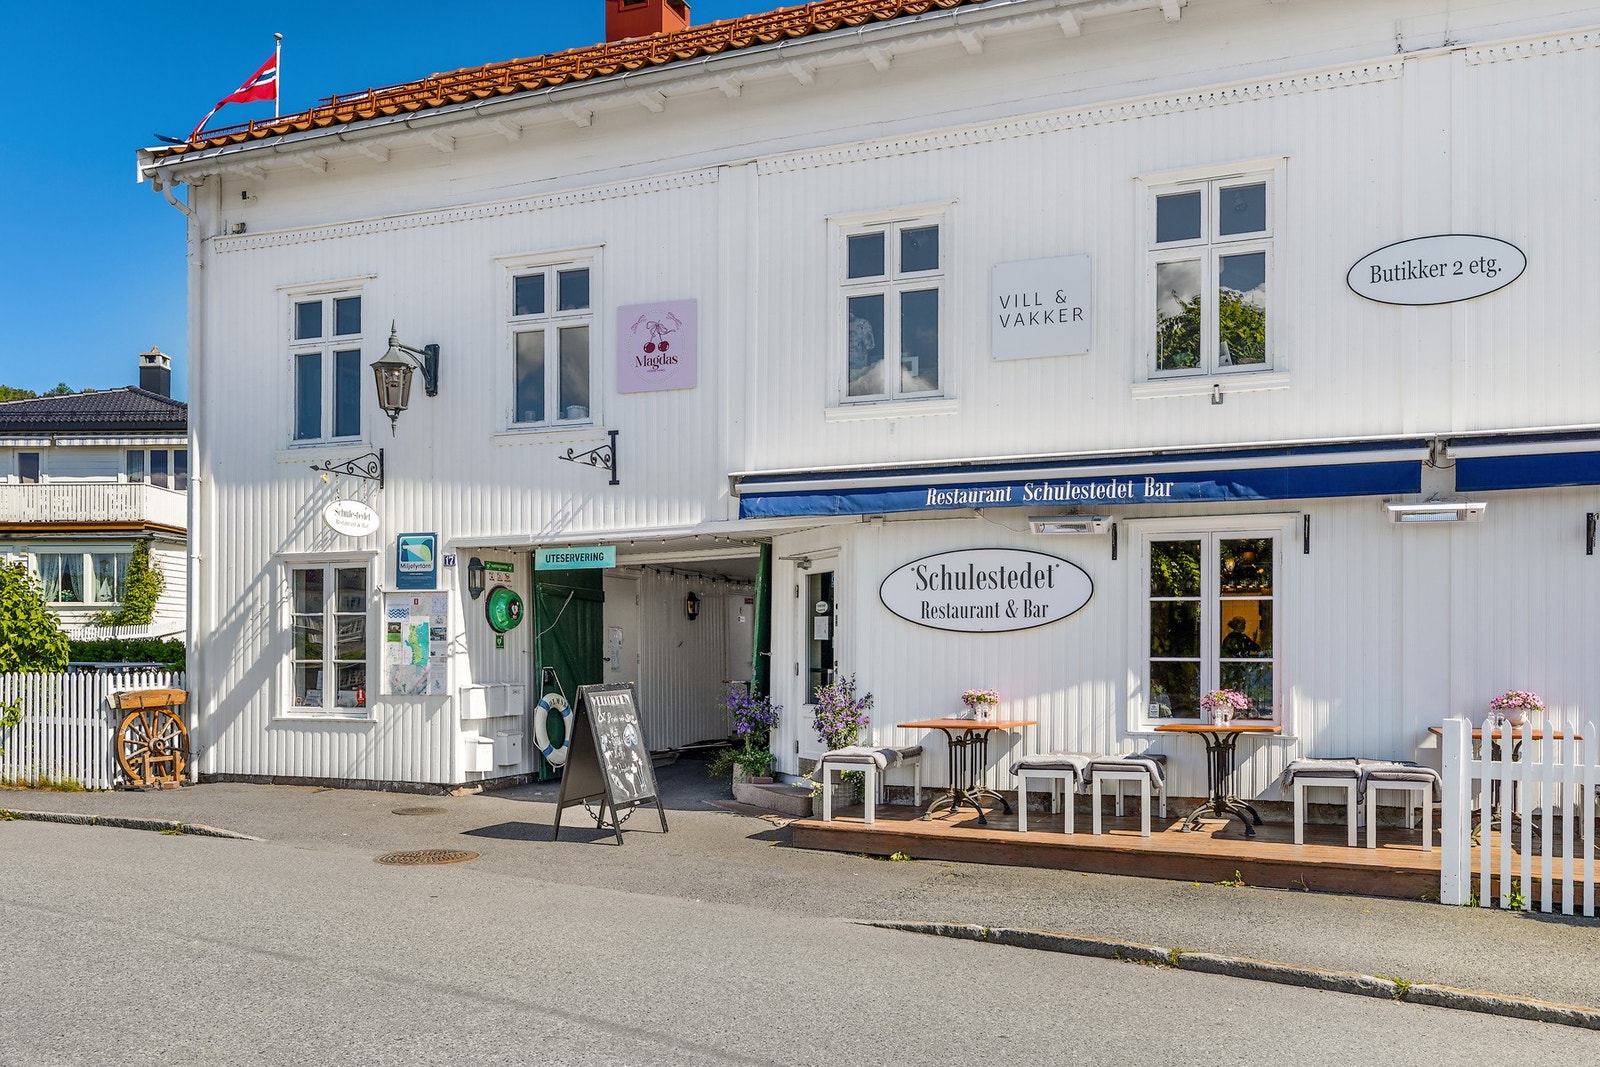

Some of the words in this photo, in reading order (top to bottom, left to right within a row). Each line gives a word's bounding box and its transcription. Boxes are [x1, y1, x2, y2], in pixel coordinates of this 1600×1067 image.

[1369, 258, 1448, 285] Butikker
[1452, 260, 1464, 276] 2
[1468, 256, 1503, 279] etg.
[999, 292, 1043, 310] VILL
[1055, 289, 1067, 304] &
[999, 306, 1084, 329] VAKKER
[634, 353, 679, 370] Magdas
[925, 485, 1013, 506] Restaurant
[1022, 478, 1135, 502] Schulestedet
[1143, 476, 1175, 498] Bar
[445, 555, 455, 566] 17
[545, 551, 605, 564] UTESERVERING
[915, 561, 1055, 592] Schulestedet
[920, 599, 1000, 619] Restaurant
[1004, 598, 1019, 619] &
[1023, 598, 1049, 619] Bar
